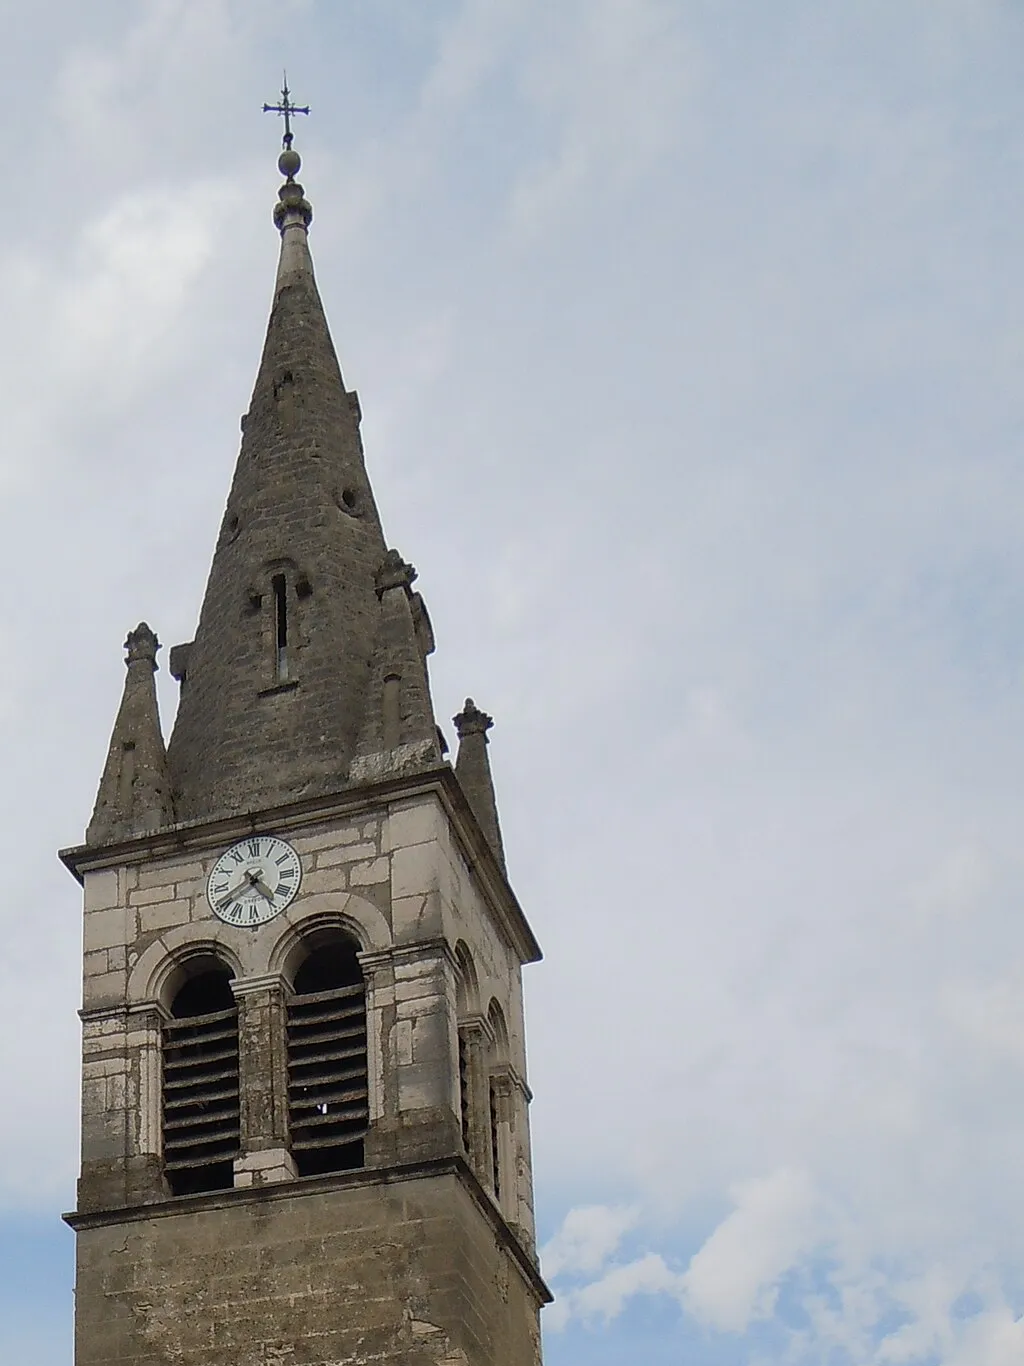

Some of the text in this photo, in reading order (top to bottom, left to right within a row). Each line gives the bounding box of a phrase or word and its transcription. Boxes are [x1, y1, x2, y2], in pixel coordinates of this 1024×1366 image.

[248, 843, 260, 857] XII
[266, 844, 274, 857] I
[231, 851, 244, 865] XI
[275, 853, 289, 865] II
[219, 867, 233, 877] X
[280, 869, 294, 879] III
[215, 882, 229, 893] IX
[274, 884, 291, 897] IIII
[249, 905, 259, 919] VI
